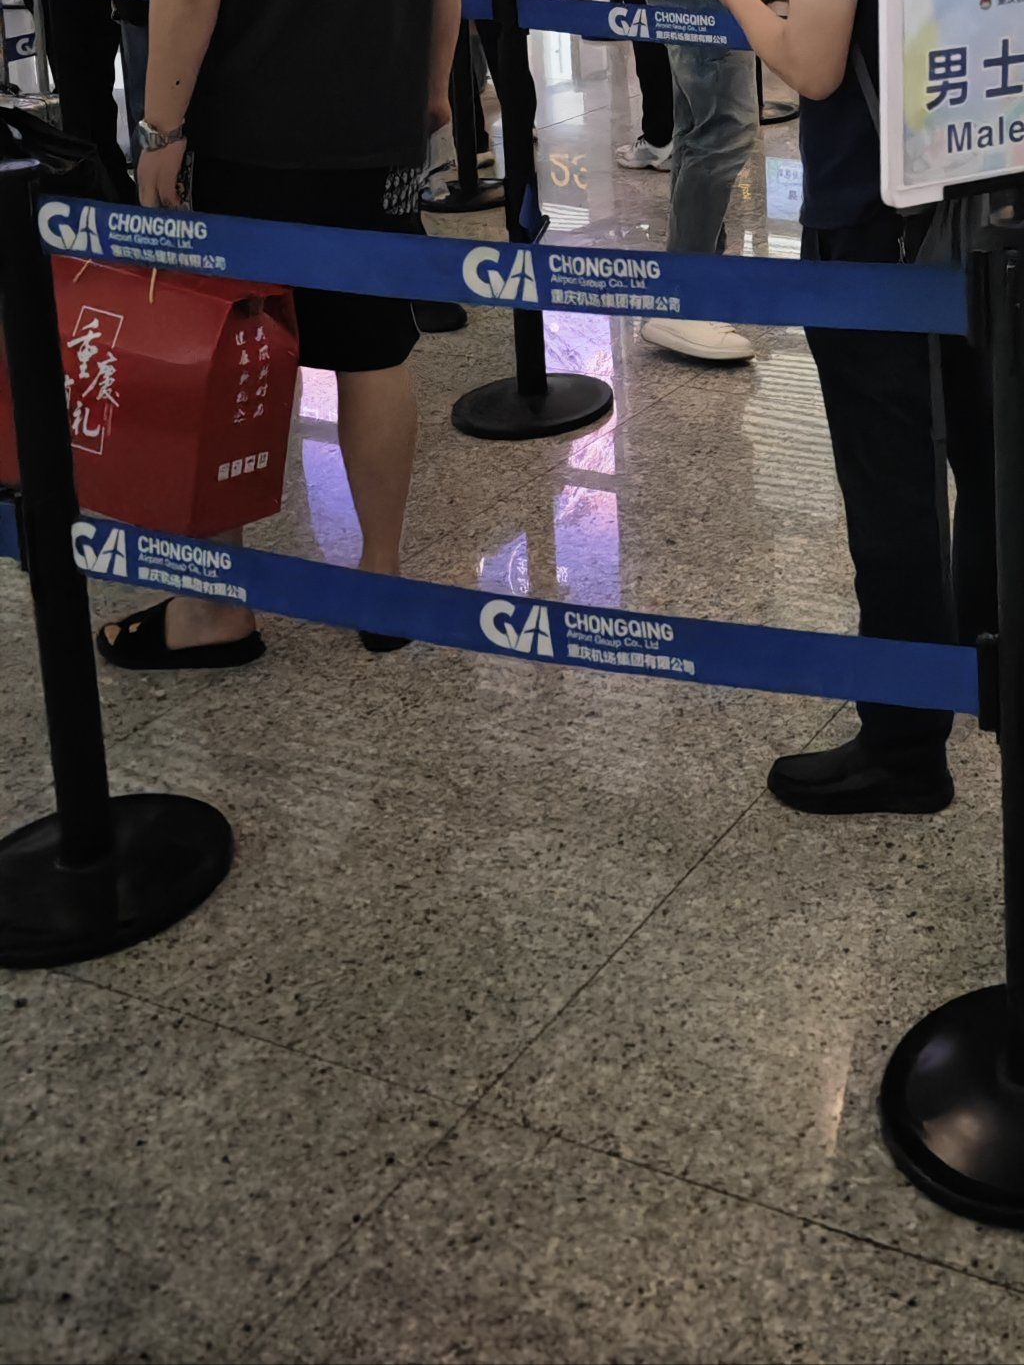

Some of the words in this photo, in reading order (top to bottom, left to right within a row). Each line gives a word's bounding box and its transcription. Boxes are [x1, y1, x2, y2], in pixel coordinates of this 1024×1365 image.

[654, 11, 716, 26] CHONGQING
[108, 212, 208, 240] CHONGQING
[549, 254, 661, 279] CHONGQING
[137, 535, 232, 570] CHONGQING
[564, 611, 674, 642] CHONGQING
